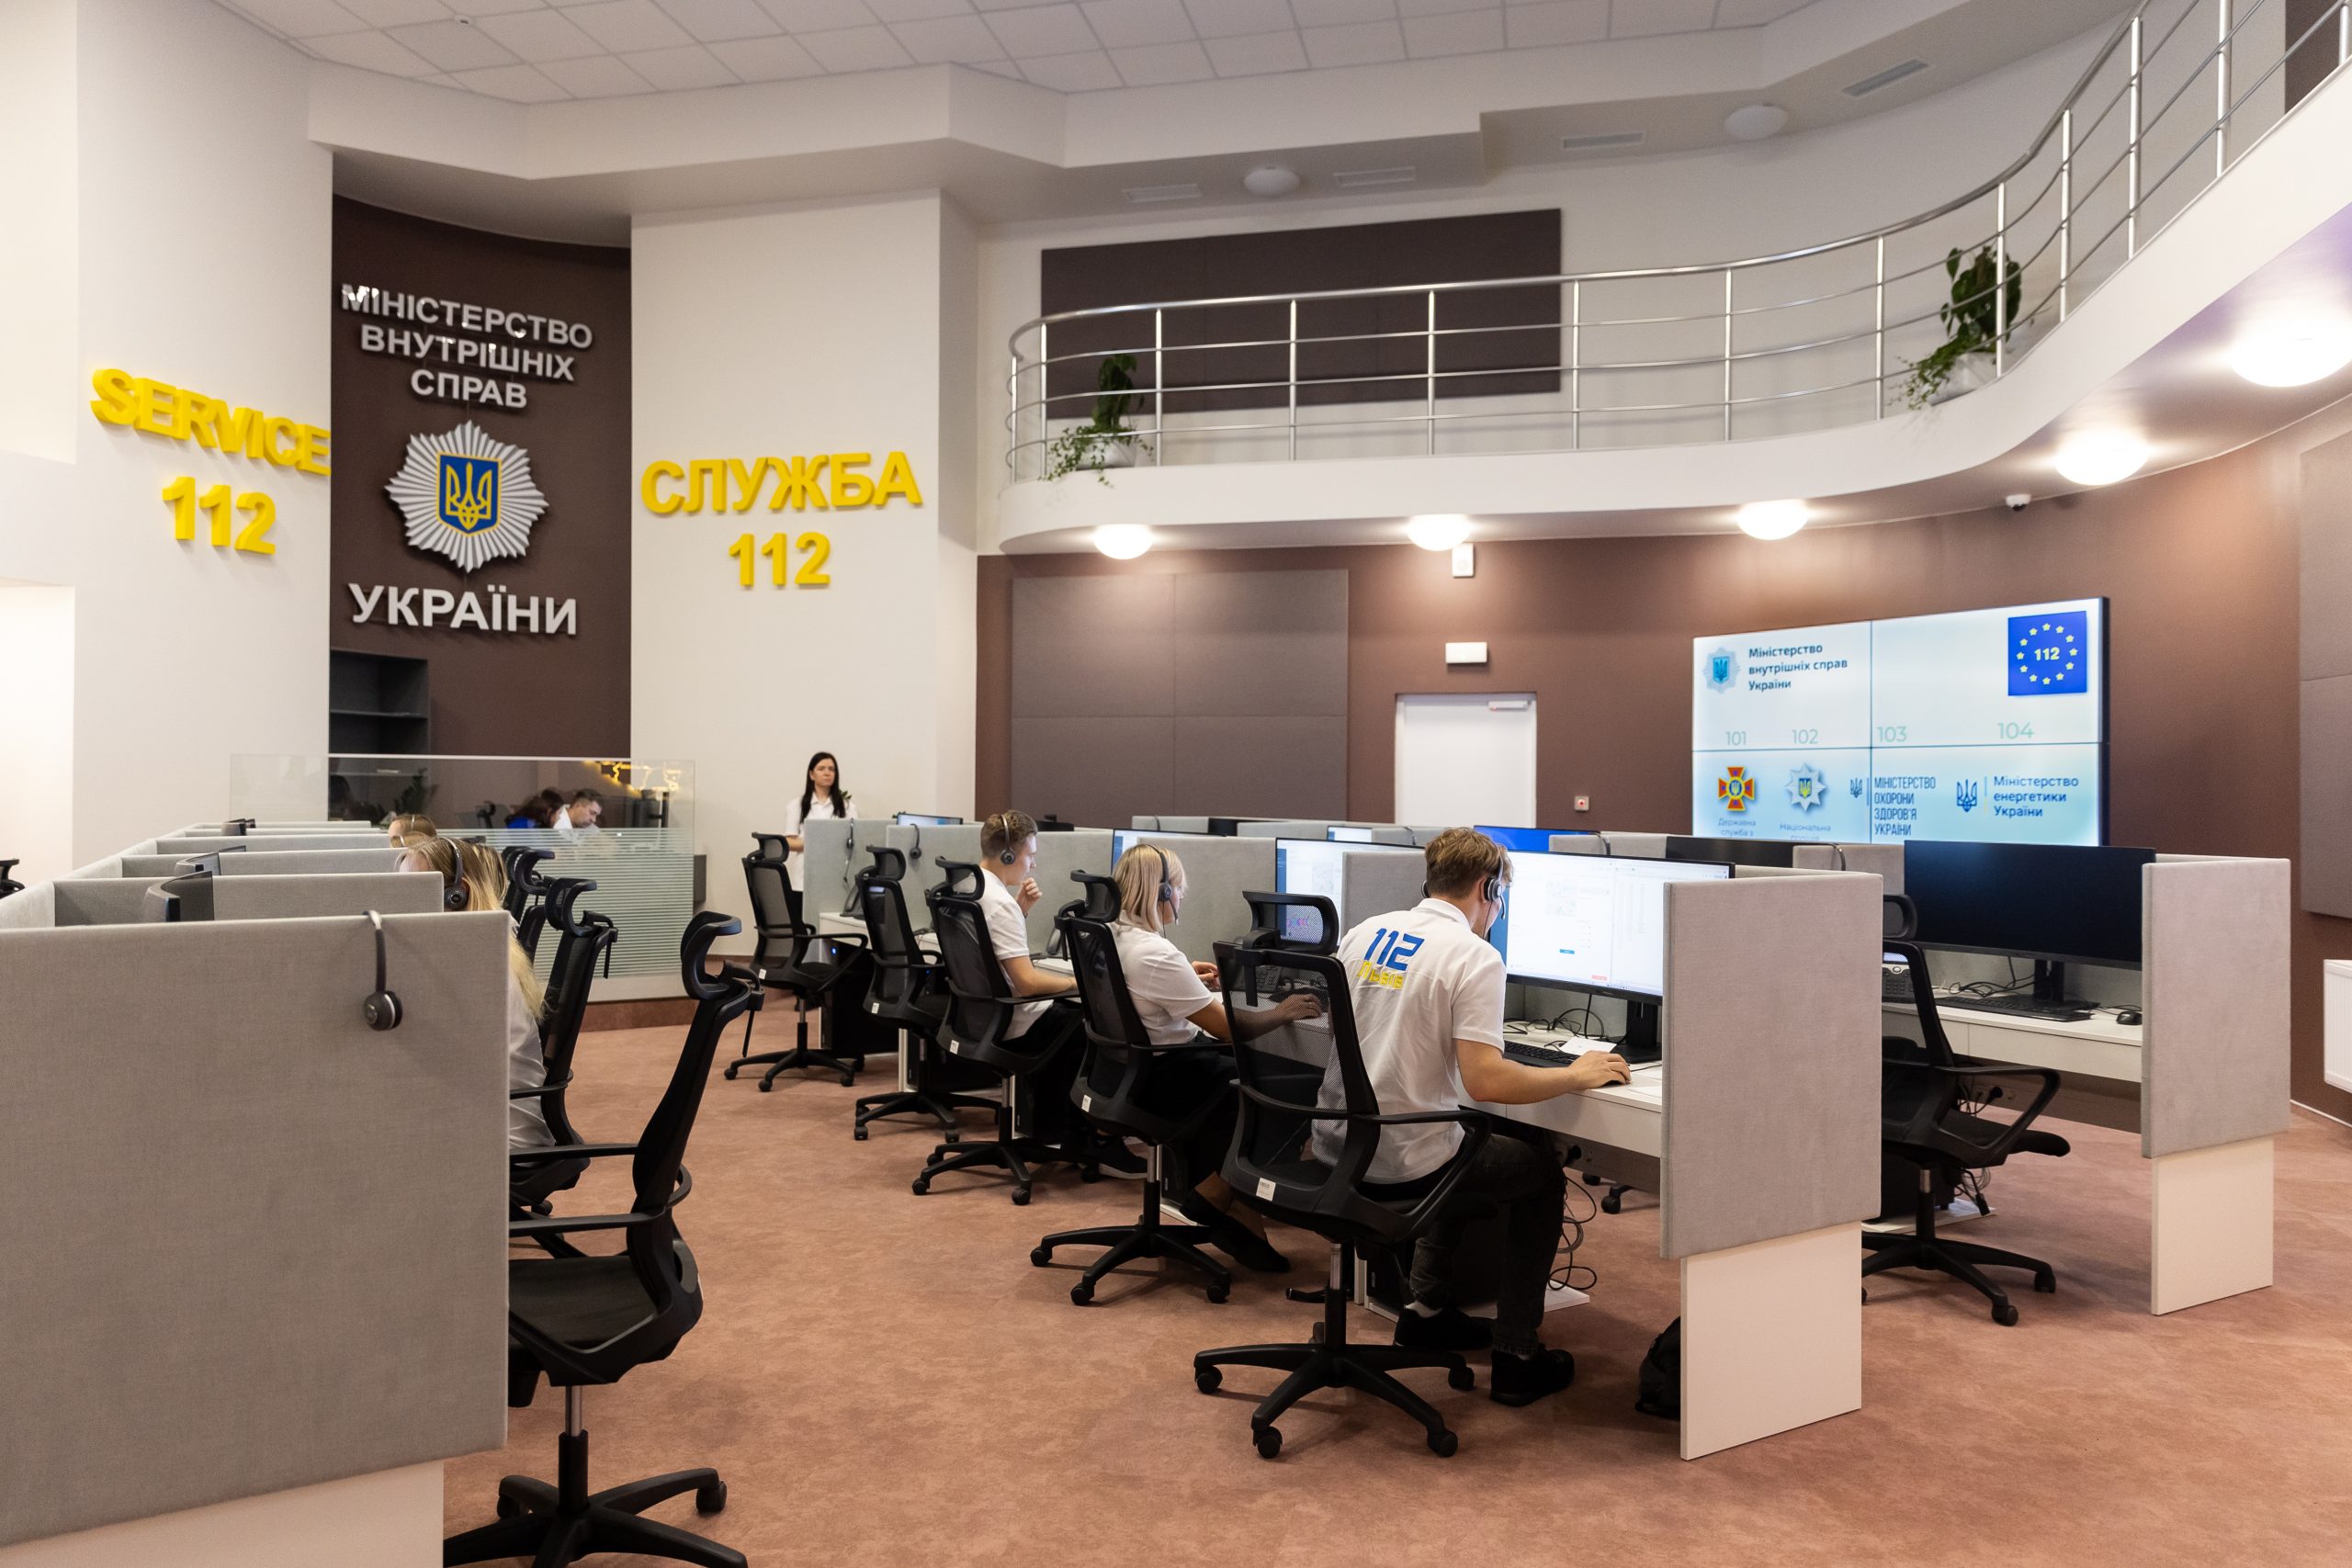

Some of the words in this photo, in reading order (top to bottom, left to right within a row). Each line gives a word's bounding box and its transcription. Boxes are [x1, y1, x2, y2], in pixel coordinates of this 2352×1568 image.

[342, 283, 594, 349] МІНІСТЕРСТВО
[361, 323, 575, 382] ВНУТРІШНІХ
[411, 368, 527, 409] СПРАВ
[90, 367, 332, 477] SERVICE
[641, 451, 922, 513] СЛУЖБА
[163, 476, 277, 555] 112
[729, 532, 831, 587] 112
[348, 583, 578, 636] УКРАЇНИ
[1748, 644, 1824, 659] Міністерство
[2034, 647, 2060, 660] 112
[1748, 660, 1810, 676] внутрішніх
[1814, 659, 1849, 672] справ
[1748, 679, 1792, 693] України
[1725, 730, 1747, 746] 101
[1792, 728, 1818, 745] 102
[1877, 725, 1907, 742] 103
[1997, 721, 2035, 739] 104
[1874, 776, 1936, 790] МІНІСТЕРСТВО
[1993, 775, 2079, 788] Міністерство
[1874, 792, 1914, 805] ОХОРОНИ
[1994, 791, 2067, 804] енергетики
[1994, 805, 2043, 818] України
[1874, 822, 1912, 836] УКРАЇНИ
[1364, 928, 1425, 971] 112
